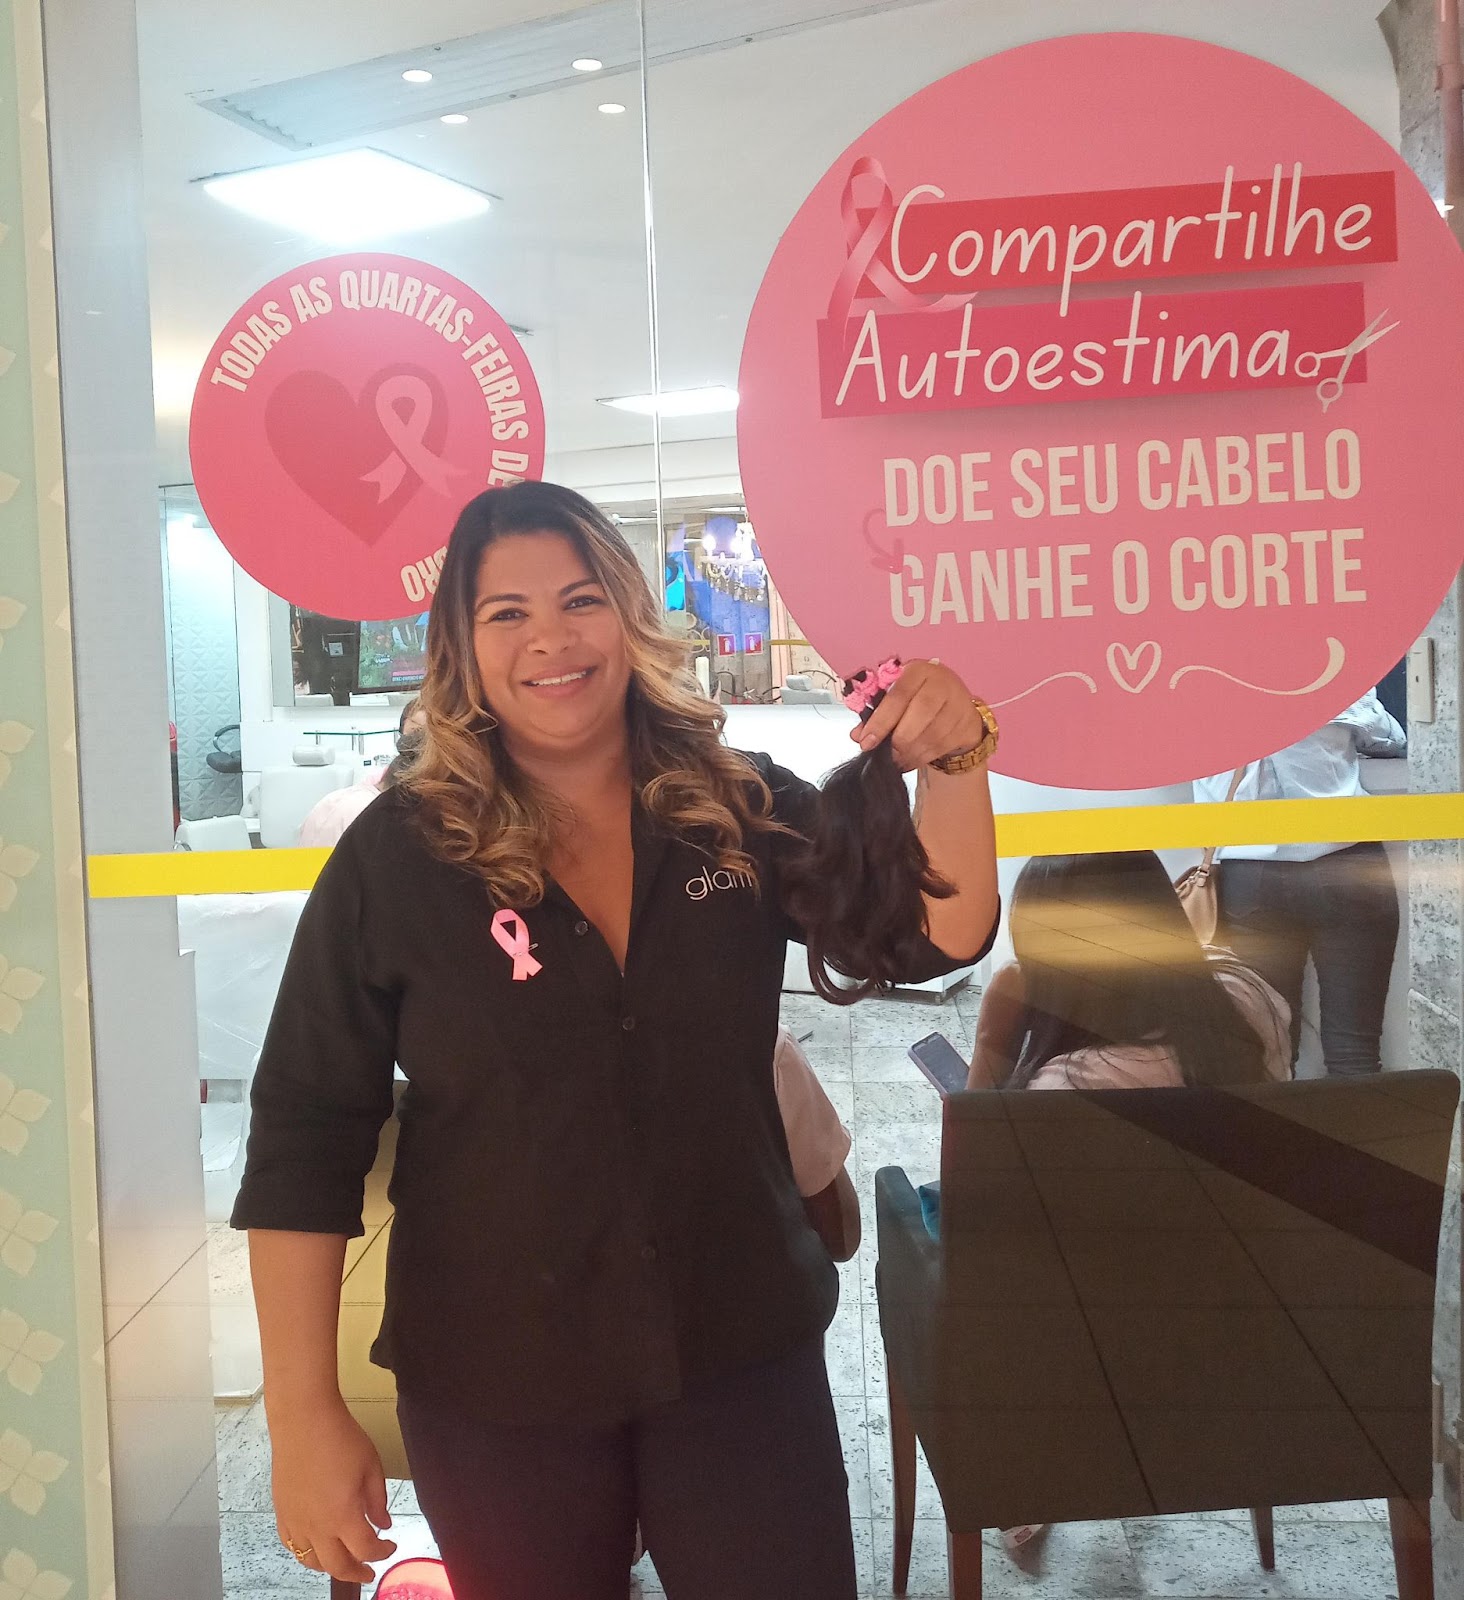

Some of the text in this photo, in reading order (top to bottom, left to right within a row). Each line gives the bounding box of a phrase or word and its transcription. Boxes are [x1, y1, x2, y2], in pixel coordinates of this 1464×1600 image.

[891, 162, 1373, 317] Compartilhe
[210, 300, 293, 393] TODAS
[289, 276, 333, 324] AS
[339, 269, 529, 441] QUARTAS-FEIRAS
[836, 290, 1289, 407] Autoestima
[884, 427, 1362, 527] DOE SEU CABELO
[889, 527, 1368, 628] GANHE O CORTE
